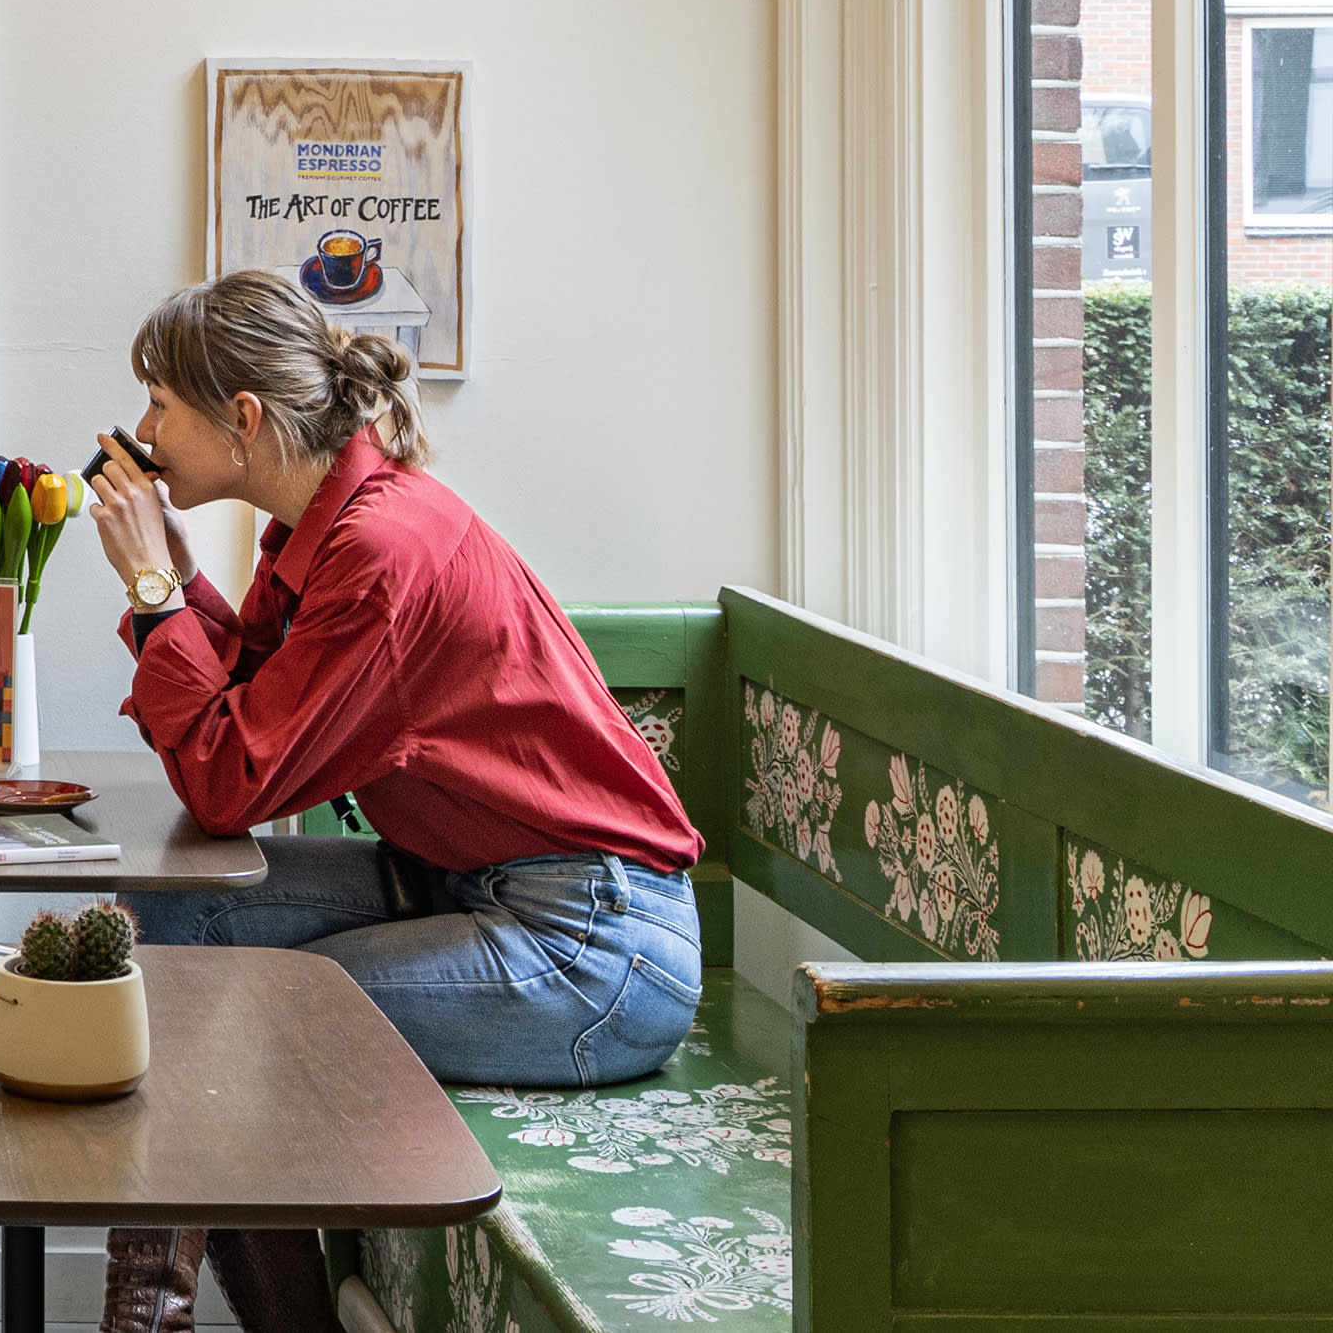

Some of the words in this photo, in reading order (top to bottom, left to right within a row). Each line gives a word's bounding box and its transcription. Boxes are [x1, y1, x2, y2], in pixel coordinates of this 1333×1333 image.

[297, 144, 382, 157] MONDRIAN
[298, 159, 381, 172] ESPRESSO
[246, 195, 280, 219] THE
[283, 194, 329, 223] ART
[358, 196, 441, 224] COFFEE
